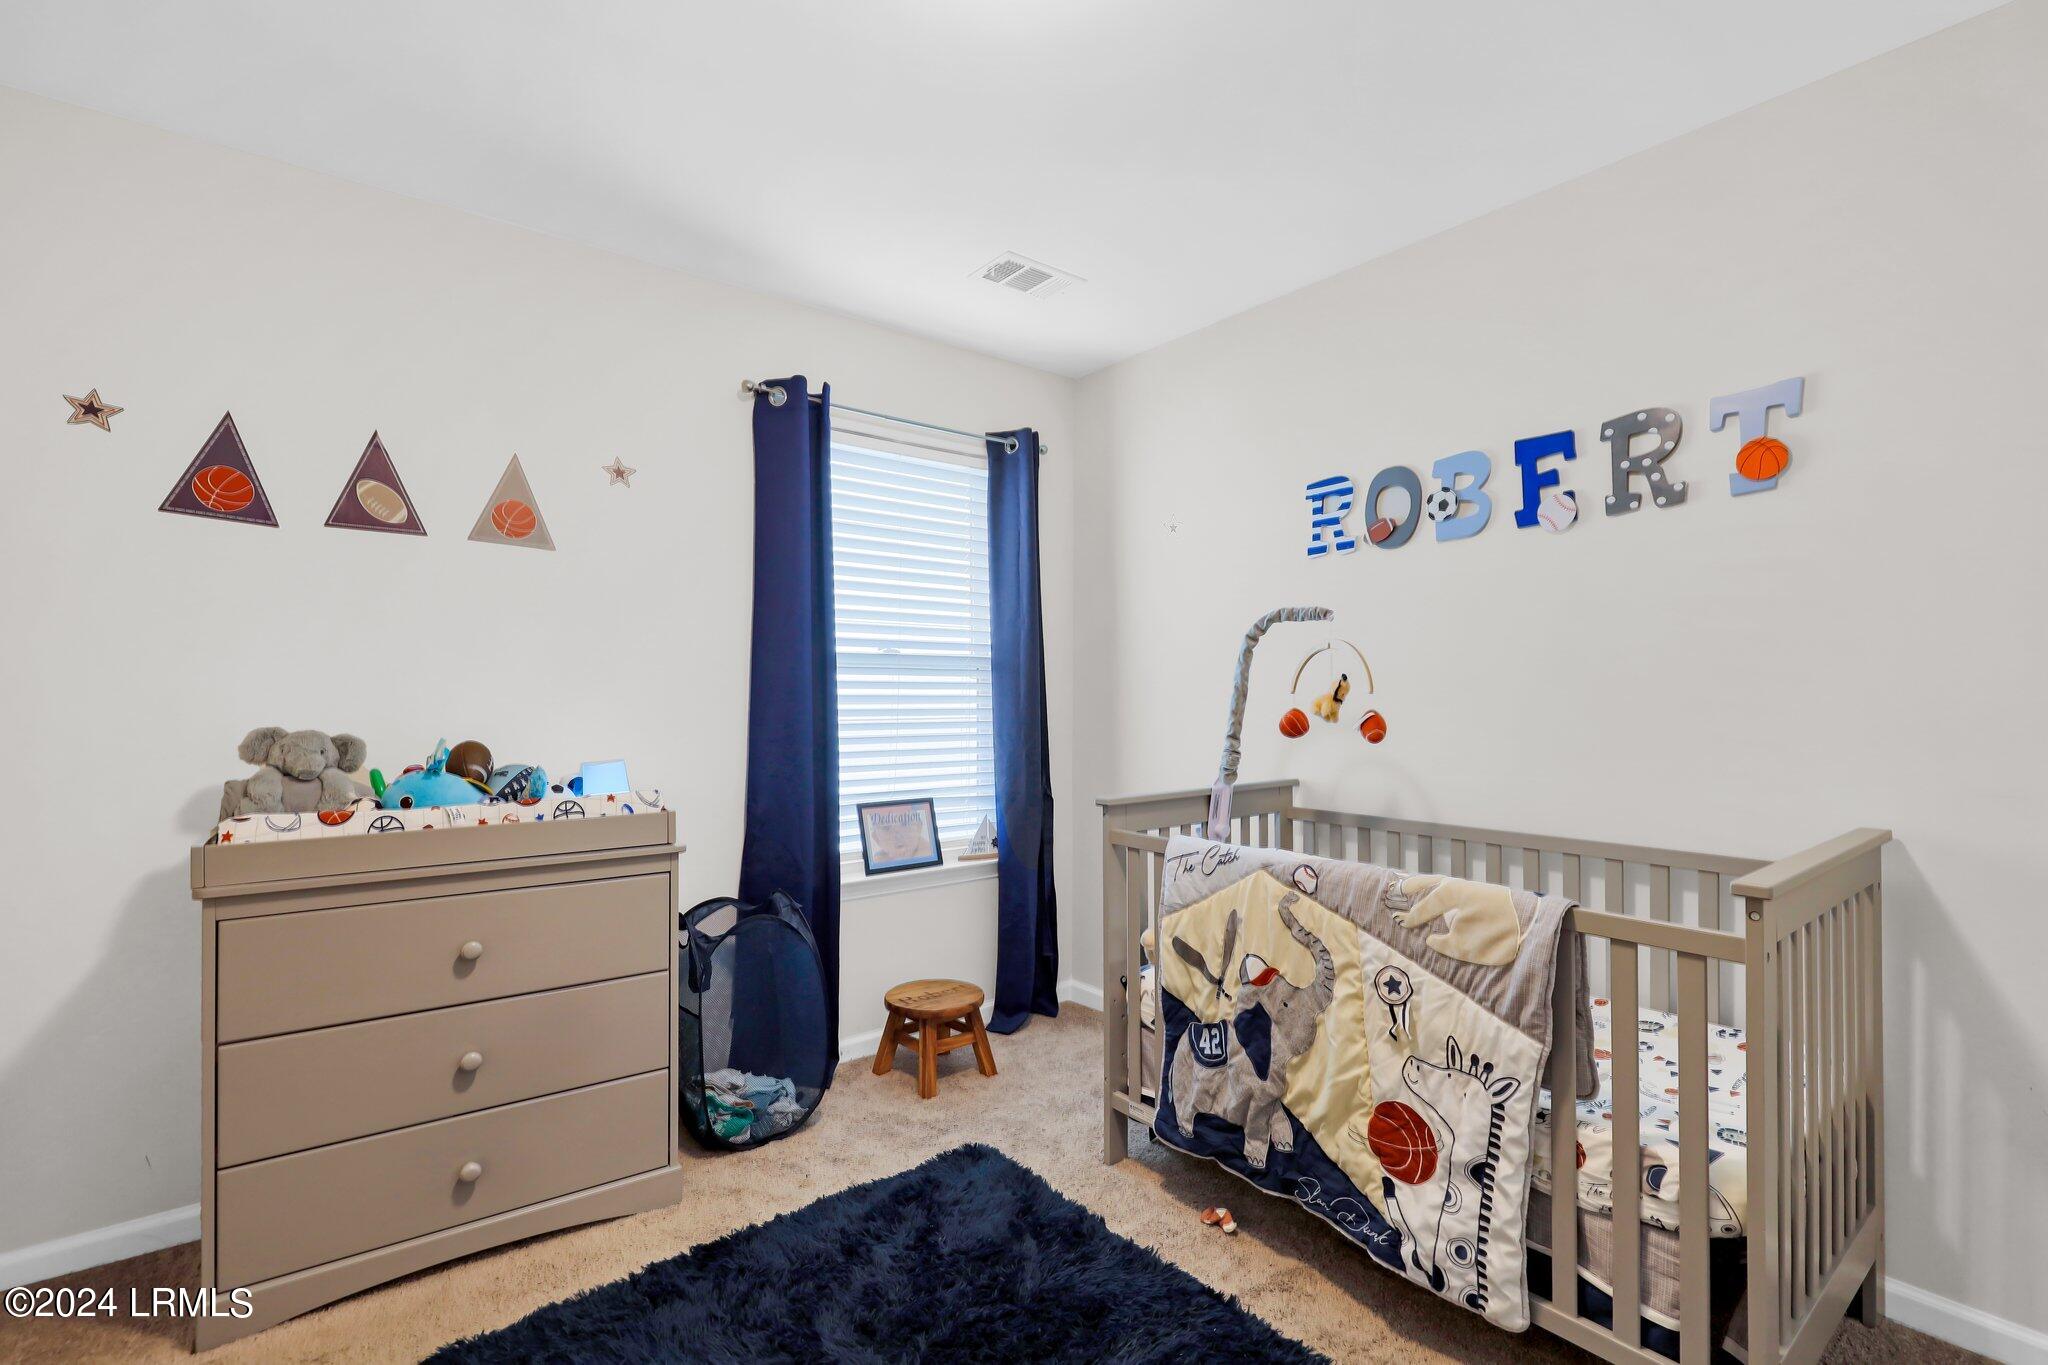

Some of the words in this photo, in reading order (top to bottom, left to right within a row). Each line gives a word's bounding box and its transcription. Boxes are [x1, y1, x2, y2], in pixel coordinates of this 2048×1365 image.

[1306, 376, 1805, 559] ROBERT
[870, 811, 923, 827] Dedication
[1167, 851, 1200, 882] The
[1201, 844, 1241, 876] Catch
[1199, 1027, 1223, 1055] 42
[1294, 1176, 1331, 1211] Slam
[1330, 1196, 1392, 1245] Dunk
